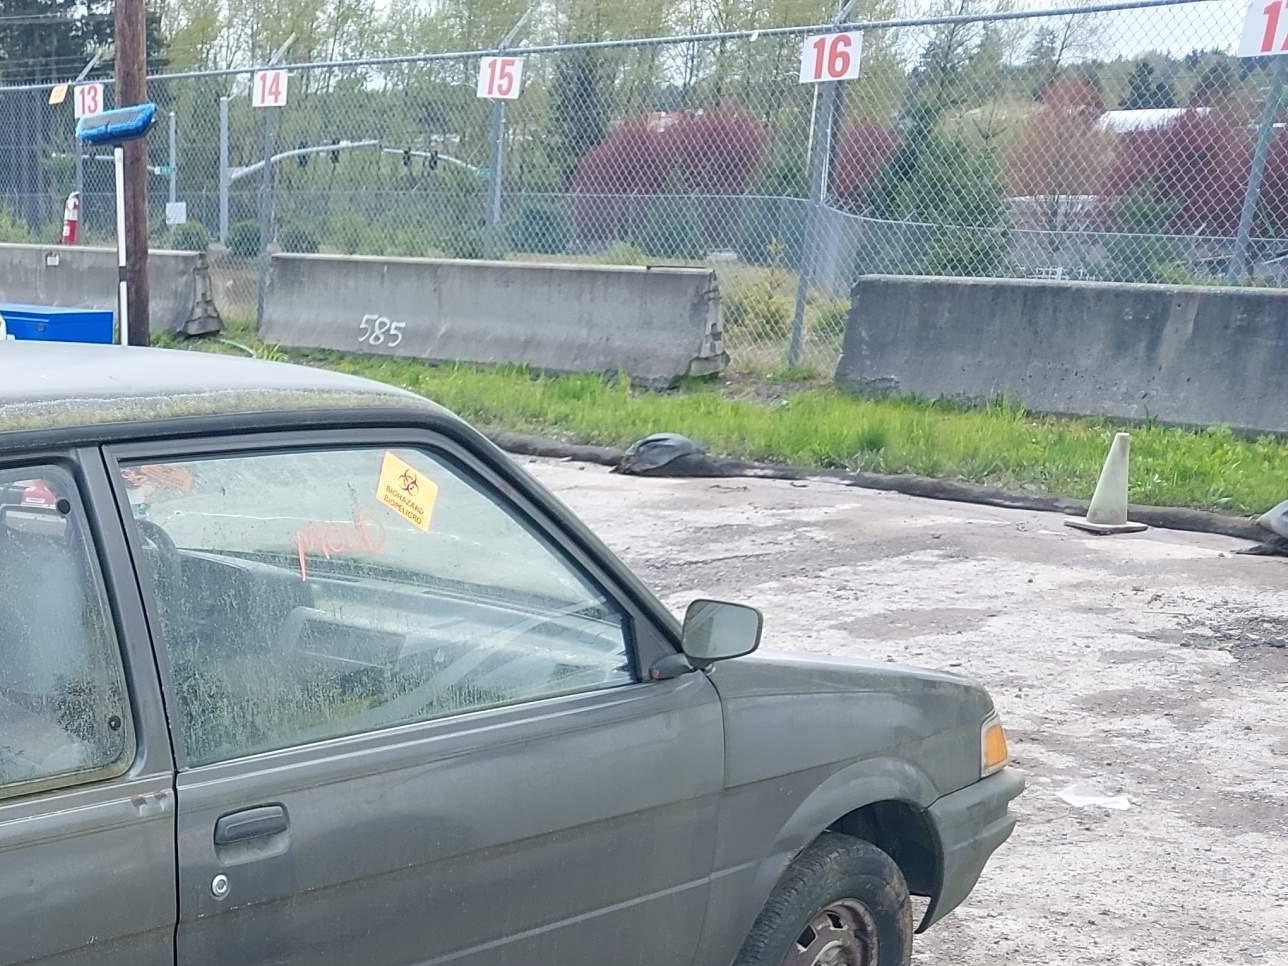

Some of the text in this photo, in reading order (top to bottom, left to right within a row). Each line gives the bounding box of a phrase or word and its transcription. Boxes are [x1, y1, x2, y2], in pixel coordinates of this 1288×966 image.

[1260, 0, 1288, 52] 1
[813, 34, 852, 79] 16
[259, 72, 282, 104] 14
[487, 59, 516, 96] 15
[79, 85, 99, 115] 13
[358, 313, 407, 347] 585
[383, 494, 423, 525] BIOPELIGRO
[385, 485, 425, 515] BIOHAZARD
